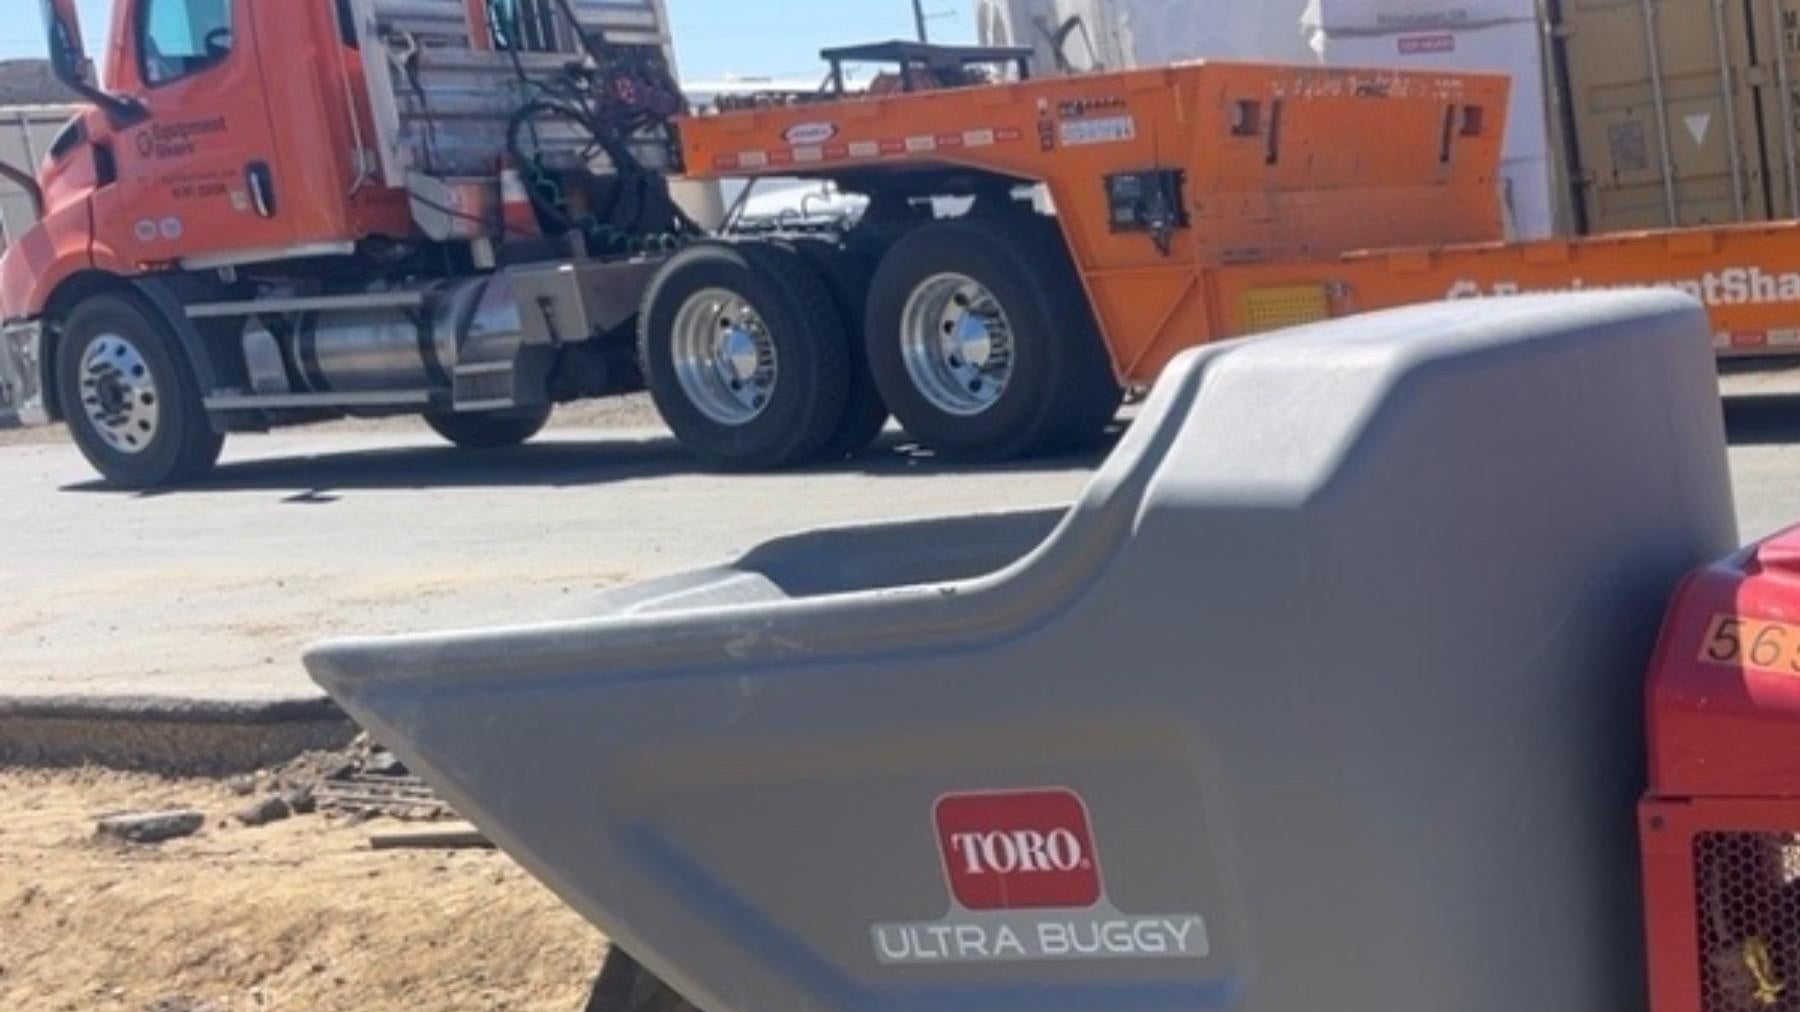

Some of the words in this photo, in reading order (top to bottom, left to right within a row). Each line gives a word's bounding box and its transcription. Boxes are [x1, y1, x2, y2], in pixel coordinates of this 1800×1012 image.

[952, 828, 1082, 874] TORO
[878, 924, 1027, 959] ULTRA
[1037, 918, 1192, 955] BUGGY
